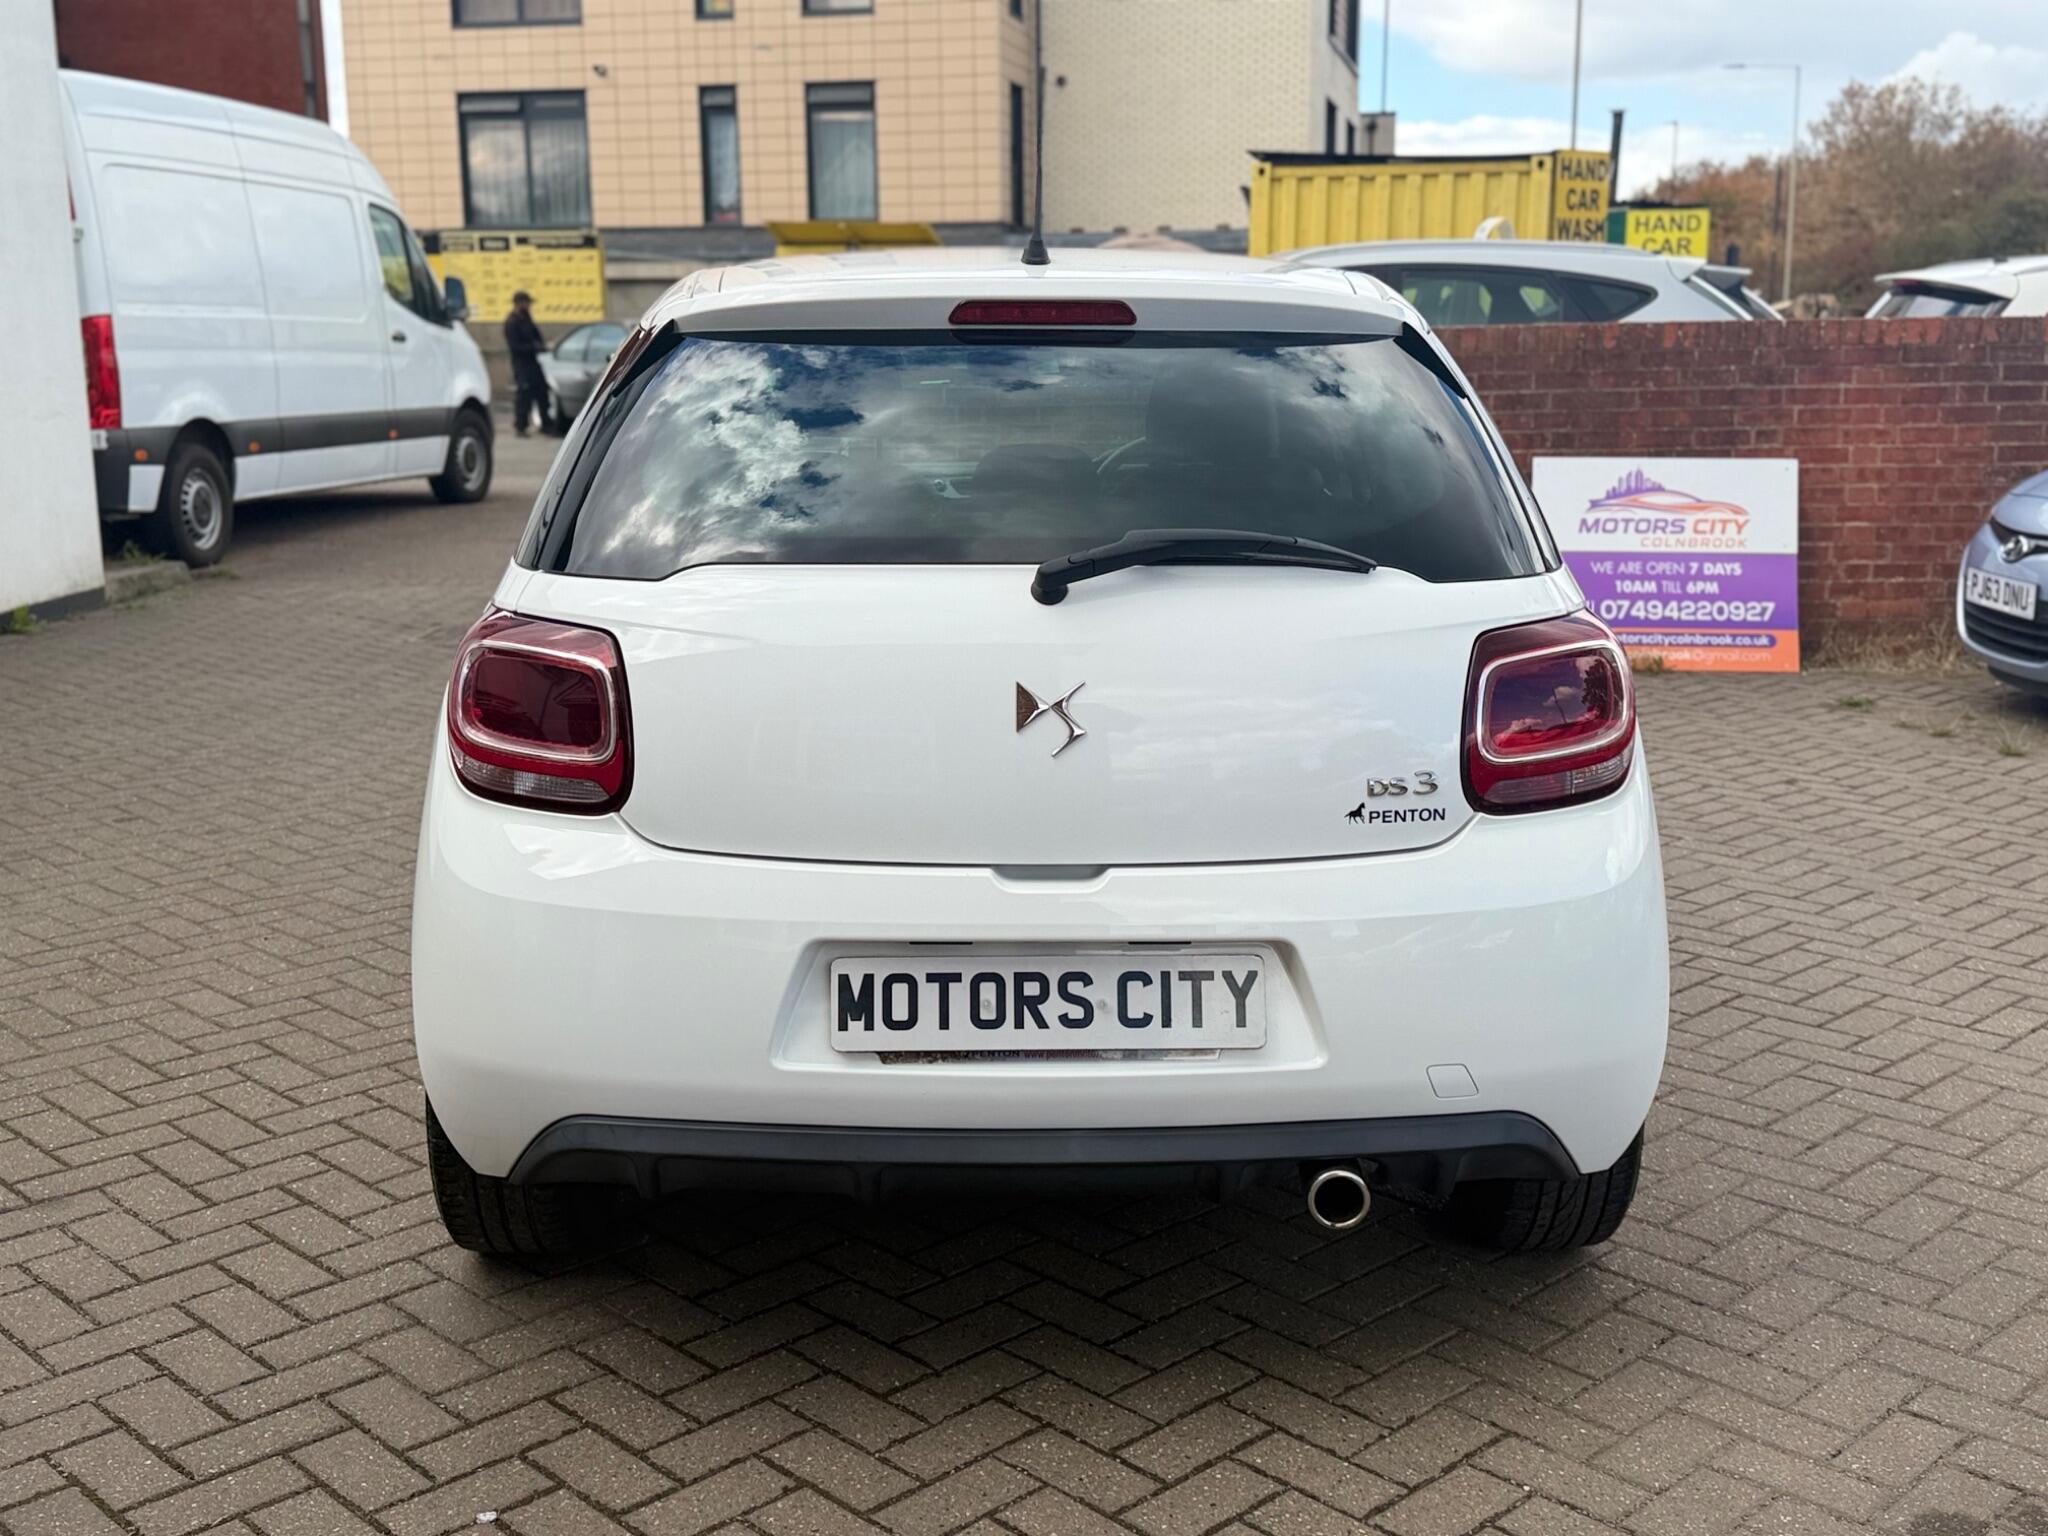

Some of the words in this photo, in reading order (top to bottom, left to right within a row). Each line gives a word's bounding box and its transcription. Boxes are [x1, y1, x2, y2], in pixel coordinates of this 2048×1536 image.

[1560, 158, 1609, 180] HAND
[1566, 188, 1600, 211] CAR
[1557, 218, 1605, 240] WASH
[1634, 214, 1701, 233] HAND
[1641, 238, 1691, 255] CAR
[1578, 517, 1686, 535] MOTORS
[1692, 518, 1749, 535] CITY
[1640, 537, 1747, 549] COLNBROOK
[1590, 561, 1614, 575] WE
[1617, 561, 1642, 575] ARE
[1646, 561, 1685, 575] OPEN
[1689, 562, 1699, 575] 7
[1703, 562, 1742, 576] DAYS
[1615, 580, 1657, 593] 10AM
[1661, 580, 1682, 593] TILL
[1686, 580, 1719, 594] 6PM
[1600, 599, 1776, 622] 07494220927
[1368, 808, 1446, 824] PENTON
[837, 971, 1094, 1032] MOTORS
[1116, 970, 1258, 1029] CITY
